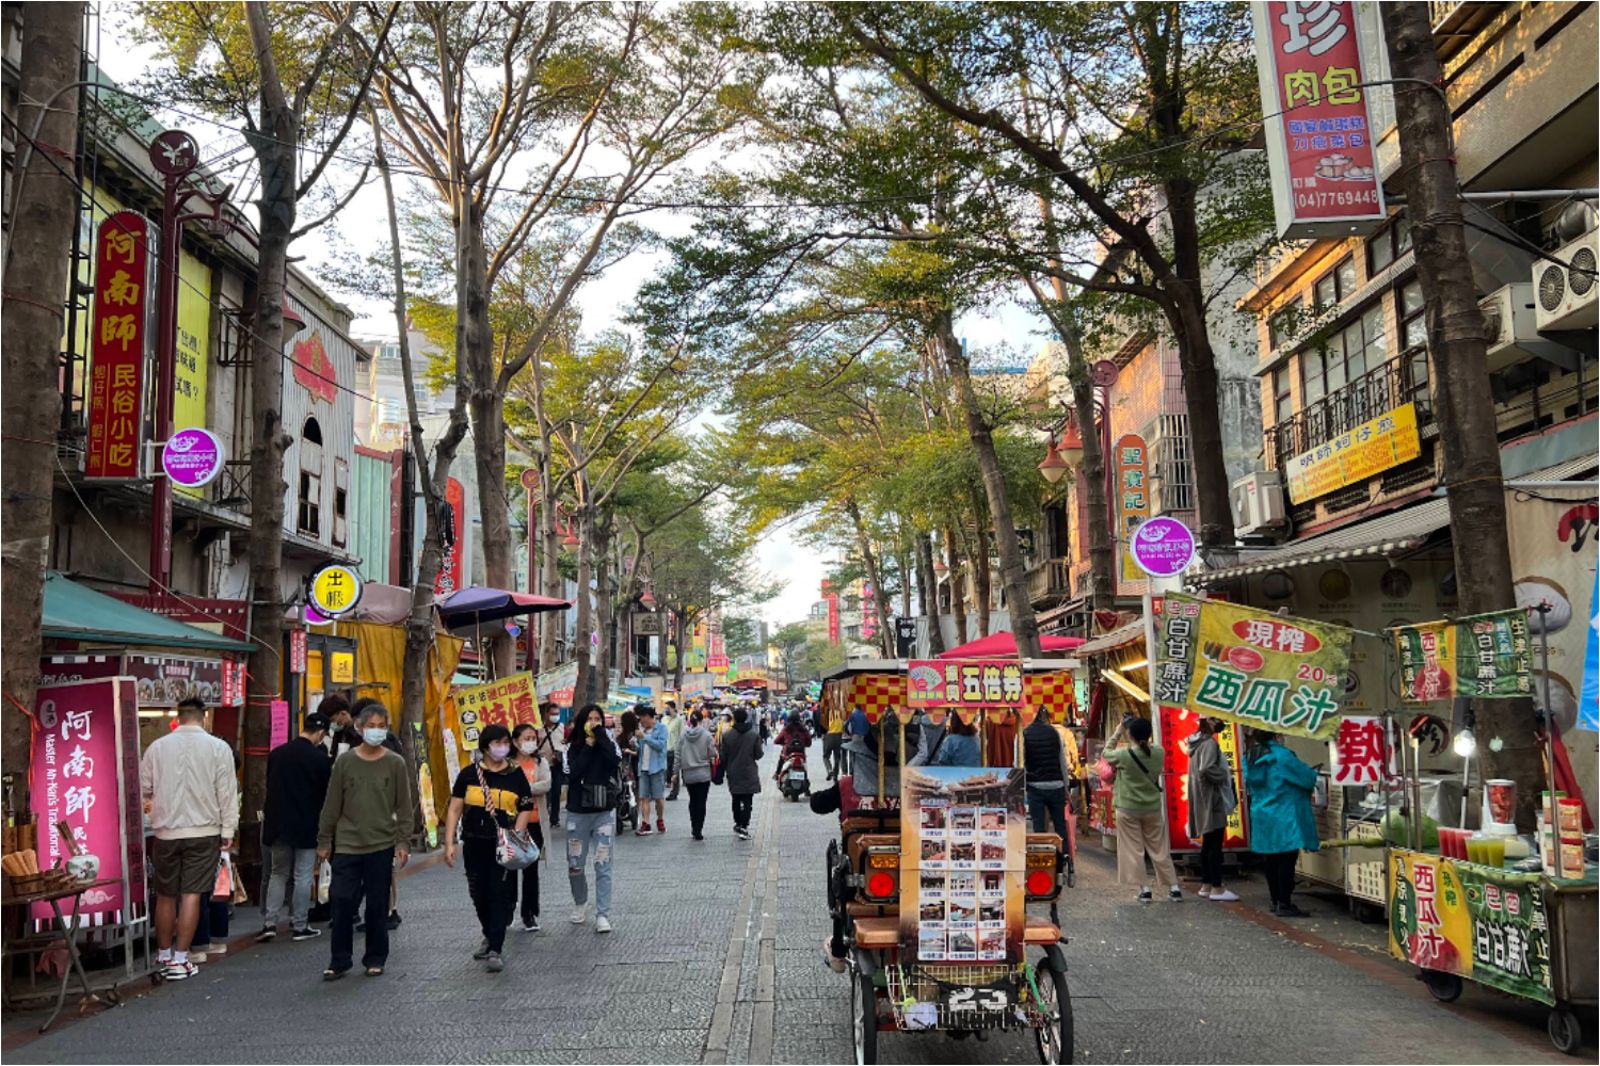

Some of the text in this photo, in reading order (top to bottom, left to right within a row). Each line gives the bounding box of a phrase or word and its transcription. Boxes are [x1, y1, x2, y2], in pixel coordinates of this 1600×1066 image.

[1280, 0, 1348, 56] 珍
[1283, 64, 1361, 110] 肉包
[1294, 189, 1379, 209] (04)7769448
[101, 228, 142, 352] 阿南師
[108, 363, 137, 468] 民俗小吃
[1167, 599, 1200, 618] 巴西
[1244, 618, 1306, 654] 現榨
[961, 663, 1023, 703] 五倍券
[1161, 617, 1191, 703] 白甘蔗汁
[1476, 634, 1497, 695] 白甘蔗汁
[478, 692, 538, 728] 特價
[1195, 664, 1338, 733] 西瓜汁
[45, 733, 57, 765] Master
[61, 709, 96, 824] 阿南師
[1335, 718, 1394, 783] 熱
[1413, 863, 1445, 959] 西瓜汁
[1485, 883, 1520, 915] 巴西
